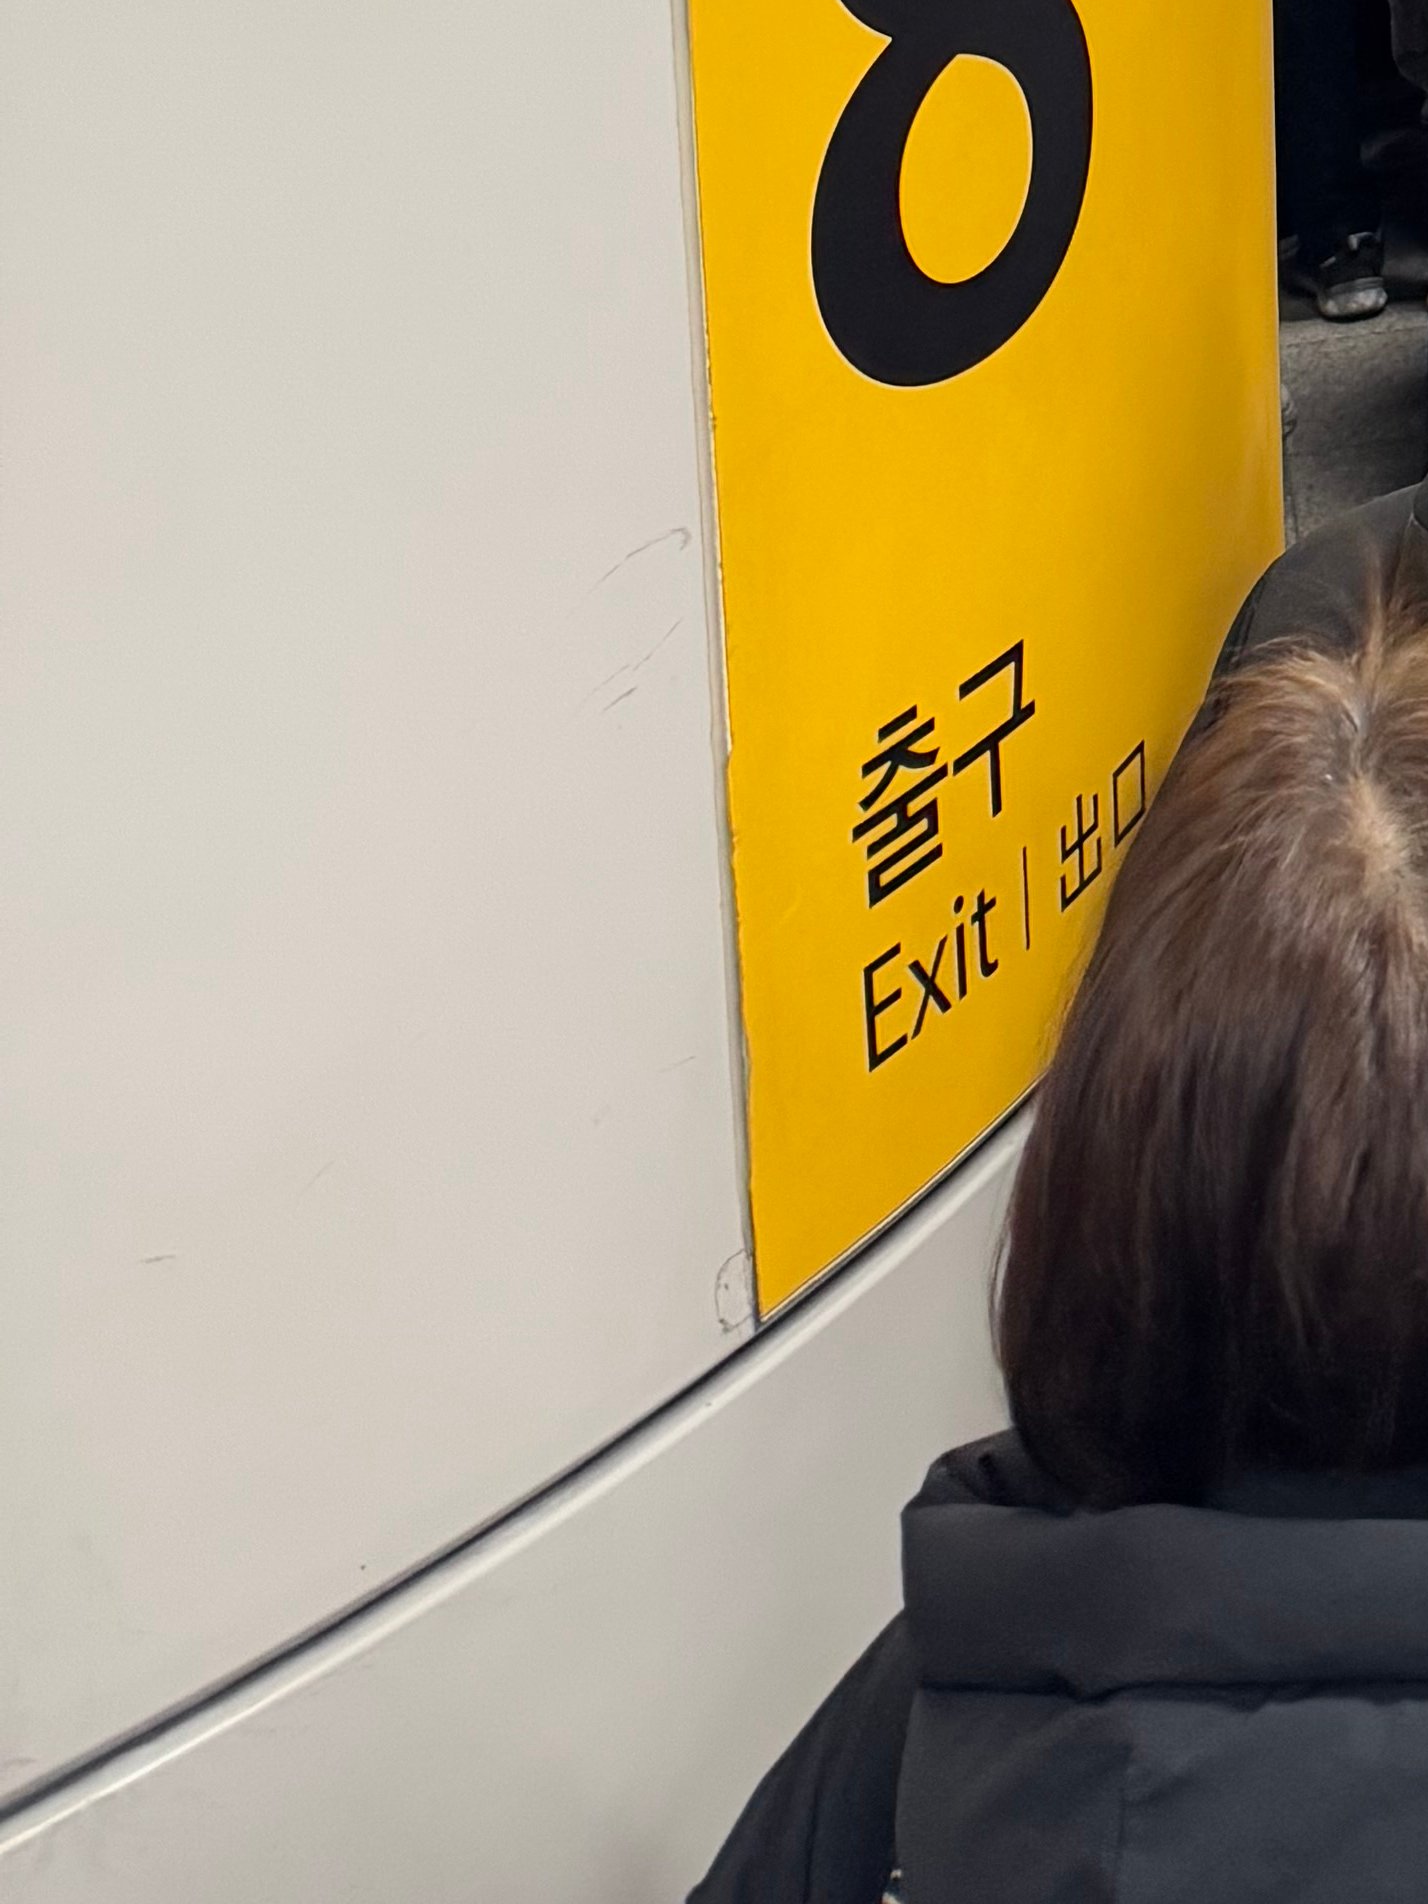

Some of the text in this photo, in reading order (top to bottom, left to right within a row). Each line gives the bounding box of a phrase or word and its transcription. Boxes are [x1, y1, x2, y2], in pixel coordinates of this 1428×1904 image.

[852, 639, 1036, 909] 출구
[1060, 739, 1146, 913] 出口
[863, 888, 999, 1073] Exit
